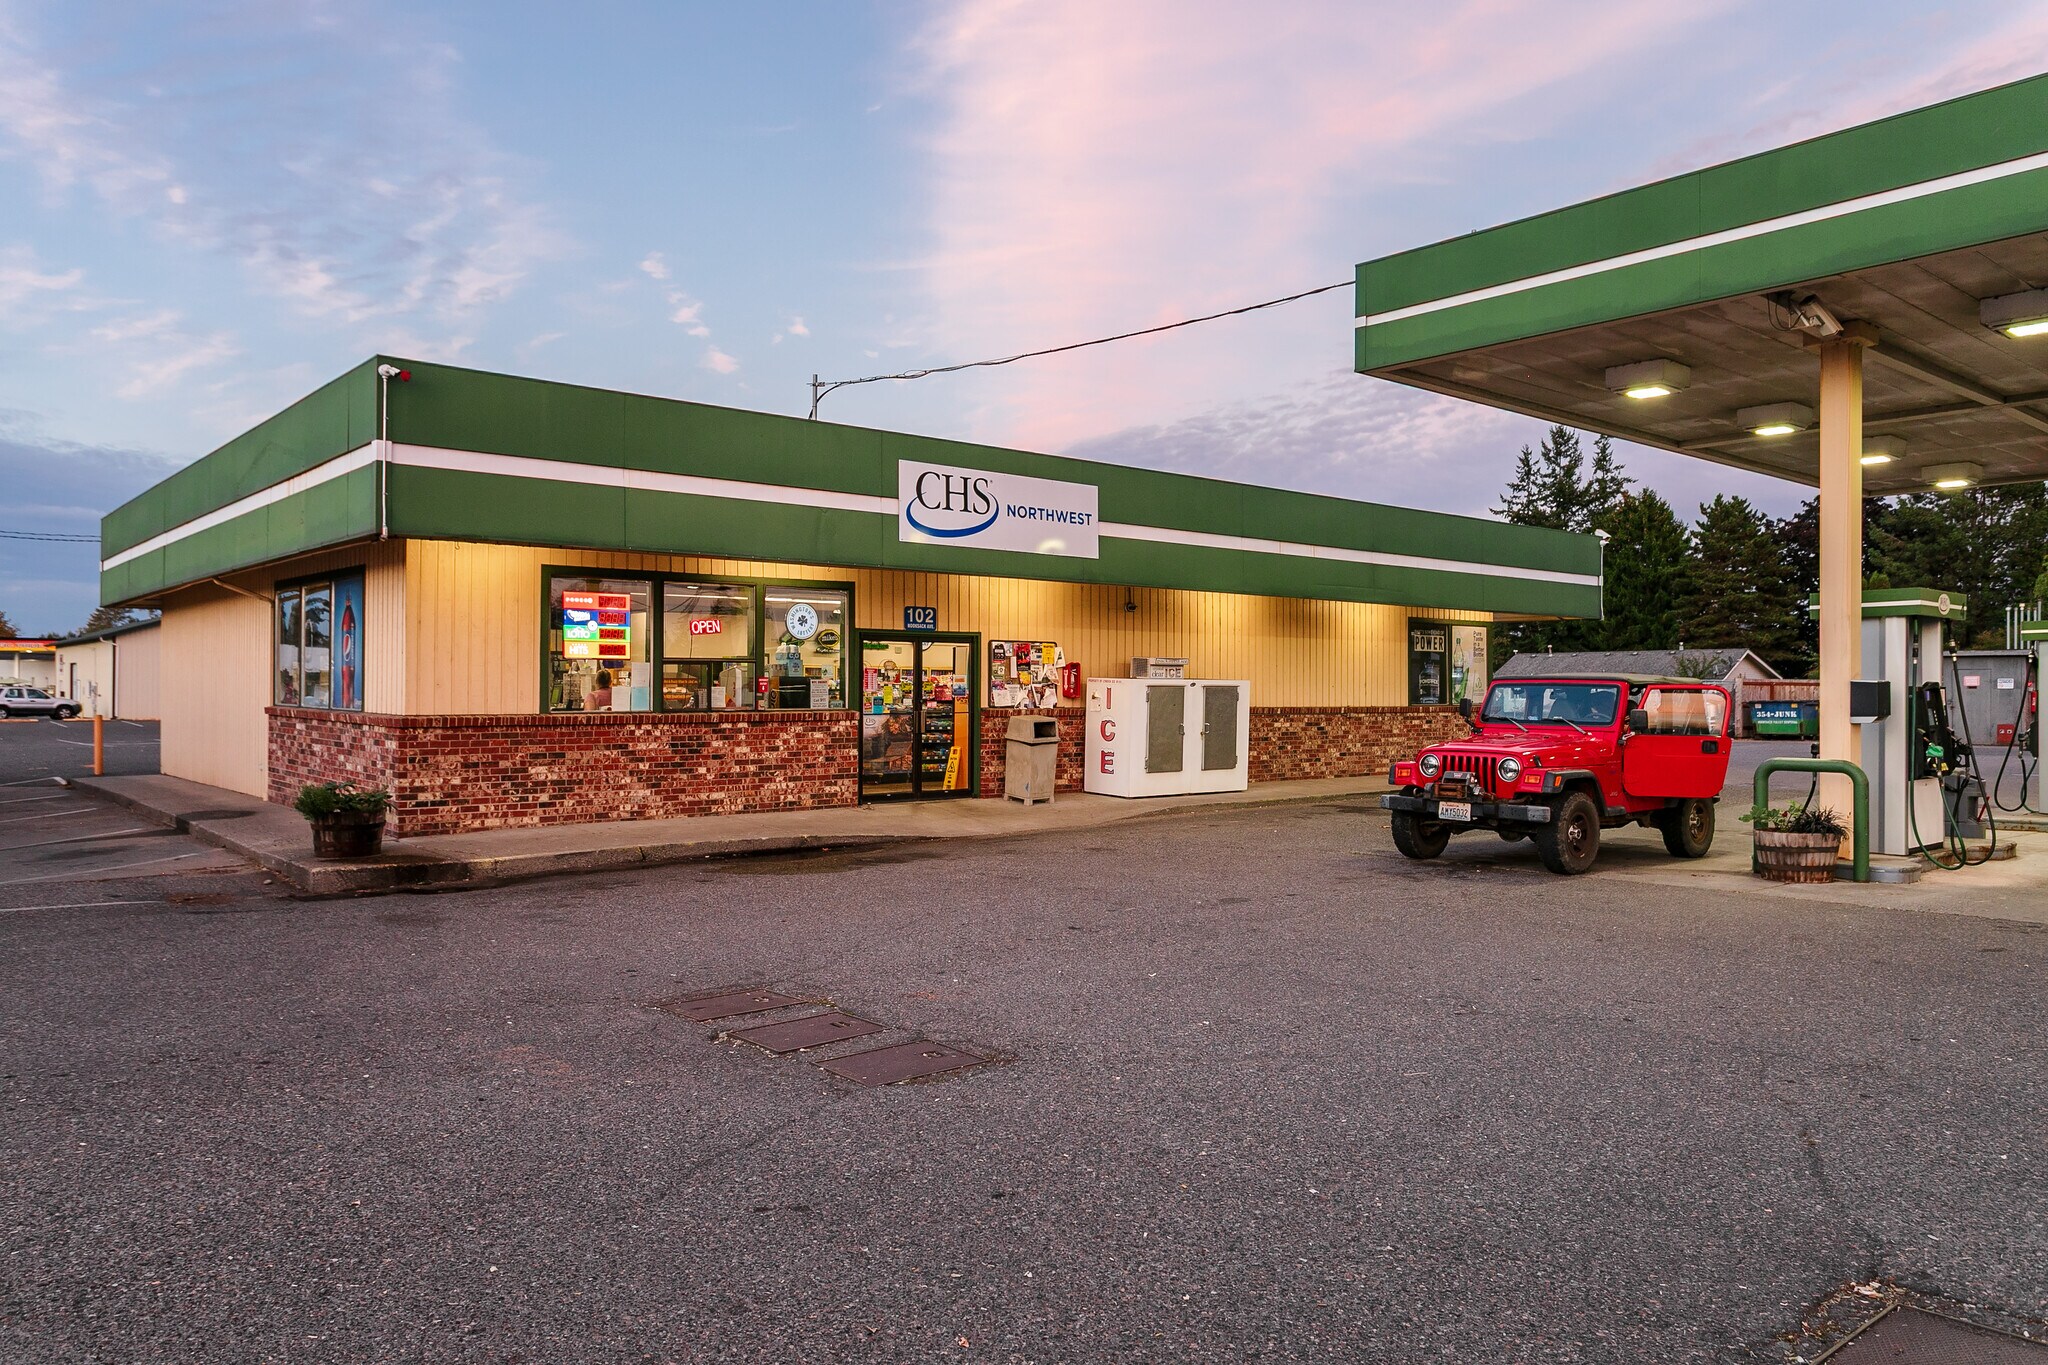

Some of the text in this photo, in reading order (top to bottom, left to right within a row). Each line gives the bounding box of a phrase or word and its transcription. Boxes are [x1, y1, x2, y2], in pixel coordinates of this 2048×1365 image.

[916, 471, 1092, 526] CHS NORTHWEST
[907, 608, 934, 623] 102
[691, 620, 721, 634] OPEN
[1414, 636, 1443, 651] POWER
[1165, 668, 1181, 678] ICE
[1100, 687, 1116, 775] ICE
